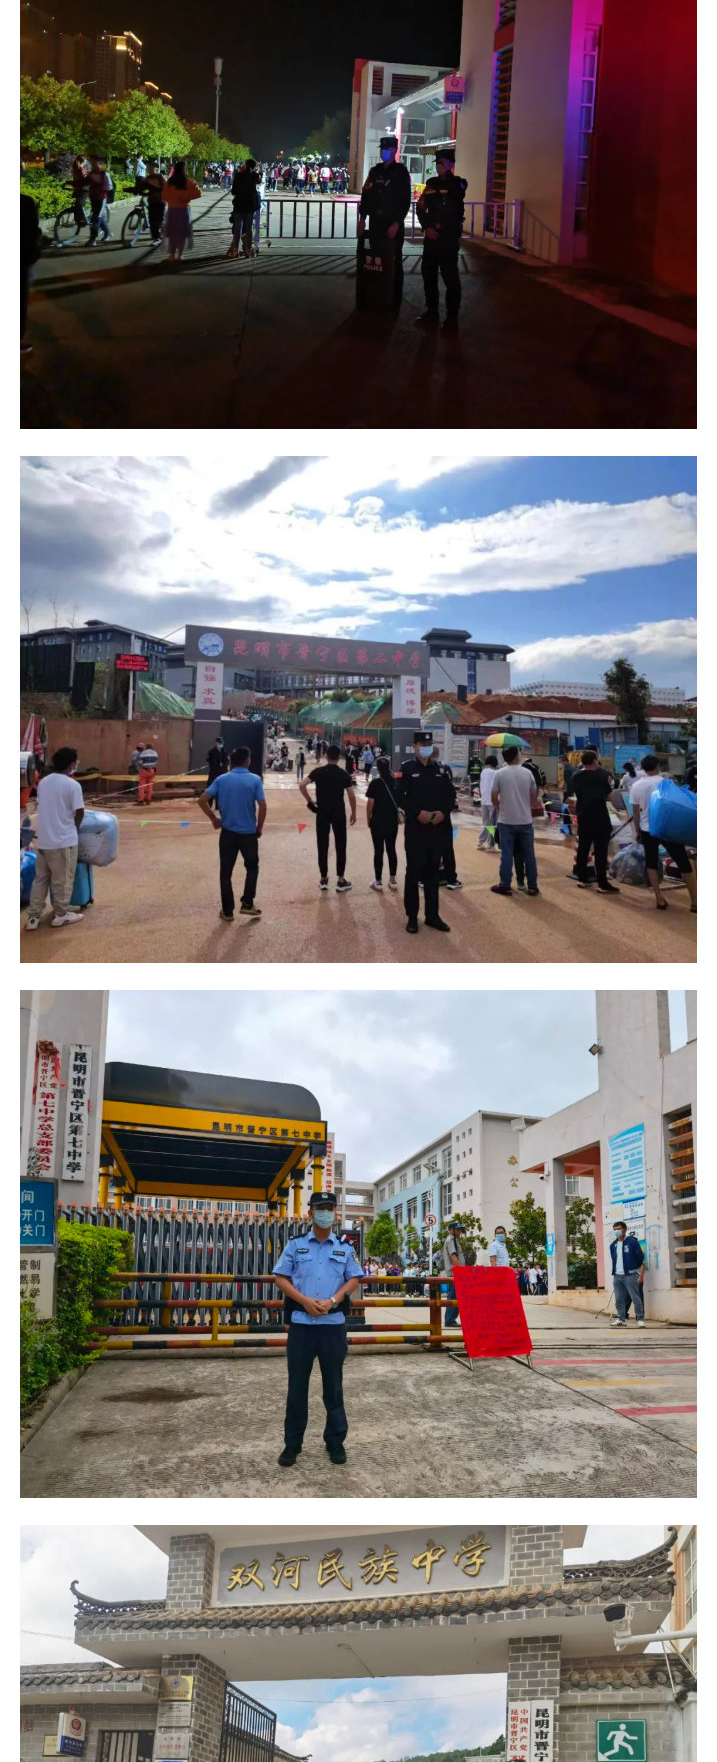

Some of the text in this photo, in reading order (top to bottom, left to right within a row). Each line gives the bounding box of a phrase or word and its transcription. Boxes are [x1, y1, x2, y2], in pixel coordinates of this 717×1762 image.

[364, 264, 383, 272] POLICE
[233, 639, 421, 670] 昆明市晋宁区第二中学
[66, 1051, 88, 1174] 昆明市晋宁区第七中学
[212, 1121, 322, 1140] 昆明市晋宁区第七中学
[427, 1216, 434, 1225] 5
[226, 1530, 493, 1591] 双河民族中学
